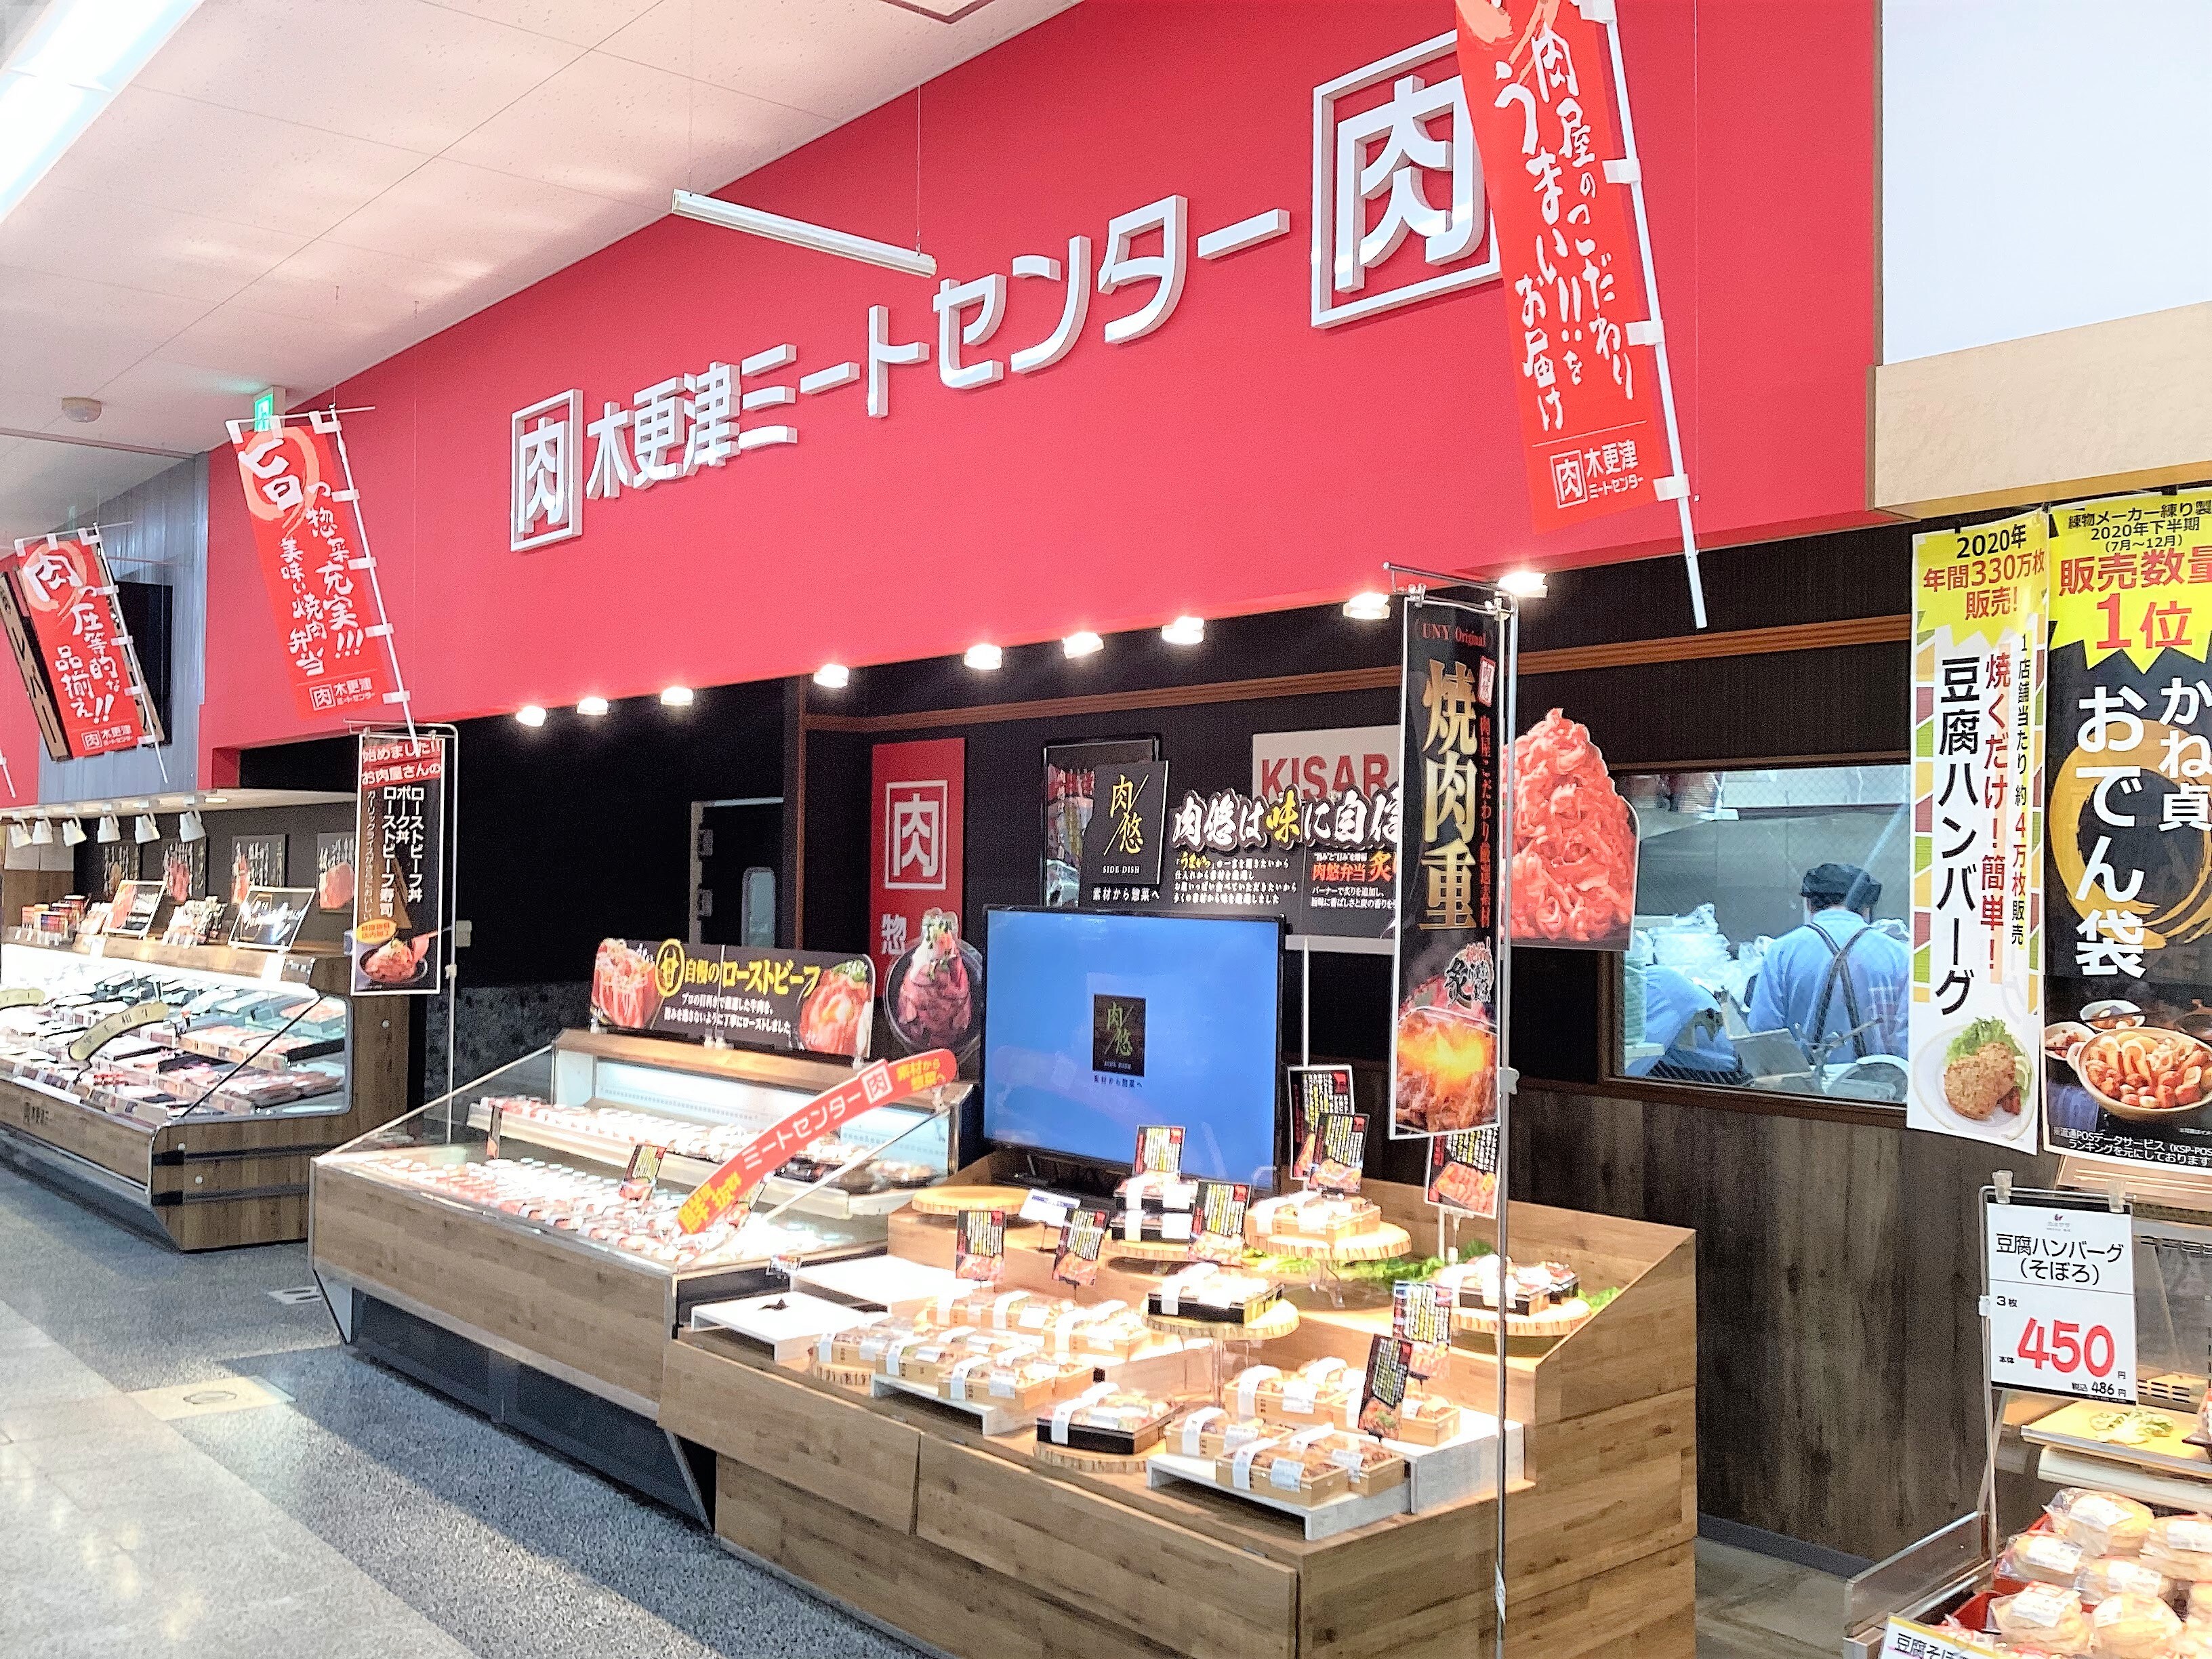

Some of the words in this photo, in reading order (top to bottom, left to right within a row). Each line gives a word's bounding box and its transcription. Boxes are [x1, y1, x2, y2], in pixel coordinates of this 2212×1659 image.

[519, 417, 565, 535] 肉
[586, 193, 1291, 501] 木更津ミートセンター
[1555, 459, 1583, 501] 肉
[1584, 439, 1639, 478] 木更津
[1589, 473, 1643, 499] ミートセンター
[1956, 523, 2027, 558] 2020年
[2091, 517, 2200, 541] 2020年下半期
[1923, 549, 2045, 592] 年間330万枚
[2059, 546, 2212, 596] 販売数量
[280, 535, 327, 676] 美味い焼肉弁当
[1965, 587, 2018, 621] 販売!
[2096, 593, 2192, 649] 1位
[1422, 623, 1450, 640] UNY
[1455, 626, 1486, 647] Original
[314, 688, 332, 708] 肉
[333, 677, 373, 696] 木更津
[363, 740, 441, 762] 始めました!!
[2158, 676, 2212, 832] かね貞
[362, 762, 441, 785] お肉屋さんの
[1420, 659, 1479, 930] 焼肉重
[396, 785, 411, 844] ポーク丼
[1980, 652, 2011, 969] 焼くだけ!簡単!
[2076, 681, 2148, 979] おでん袋
[380, 785, 397, 918] ローストビーフ寿司
[408, 786, 425, 903] ローストビーフ丼
[893, 794, 939, 877] 肉
[1935, 656, 1980, 1016] 豆腐ハンバーグ
[1103, 865, 1120, 874] SIDE
[1122, 865, 1140, 874] DISH
[1092, 886, 1160, 903] 素材から惣菜へ
[882, 914, 907, 955] 惣
[722, 959, 821, 998] ローストビーフ
[741, 1092, 861, 1170] ミートセンター
[2053, 1126, 2165, 1151] POSデータサービス
[1996, 1233, 2124, 1263] 豆腐ハンバーグ
[2020, 1258, 2100, 1285] (そぼろ)
[2018, 1317, 2115, 1378] 450
[2118, 1371, 2127, 1380] 円
[2091, 1381, 2115, 1396] 486
[2118, 1389, 2127, 1397] 円
